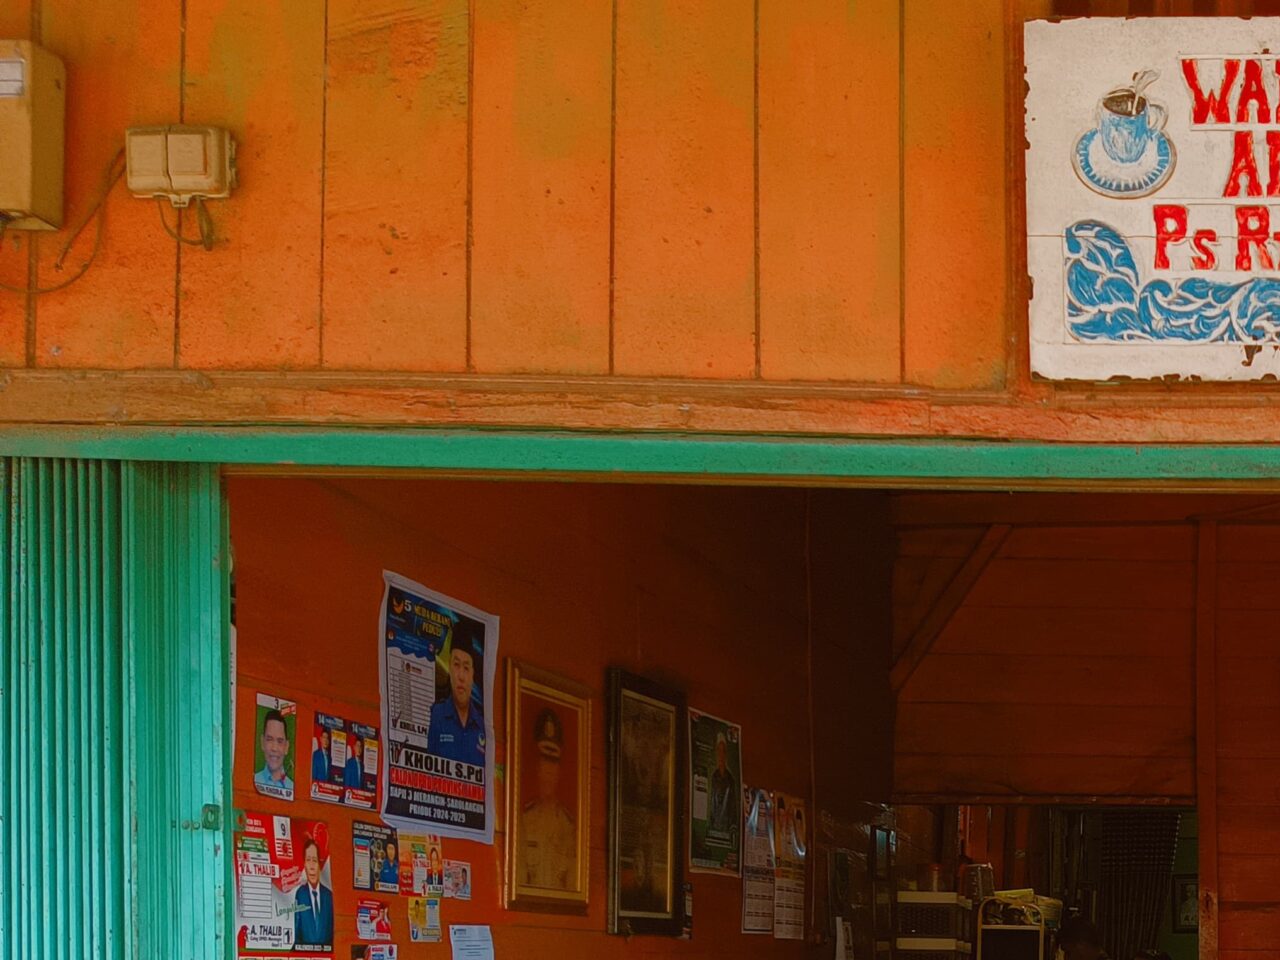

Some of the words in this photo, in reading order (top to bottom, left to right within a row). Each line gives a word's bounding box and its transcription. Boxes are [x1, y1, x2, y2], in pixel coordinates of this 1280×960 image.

[404, 600, 412, 612] 5
[274, 699, 280, 710] 3
[404, 750, 453, 776] KHOLIL
[455, 762, 483, 783] S.Pd
[281, 823, 287, 837] 9
[260, 925, 282, 937] THALIB
